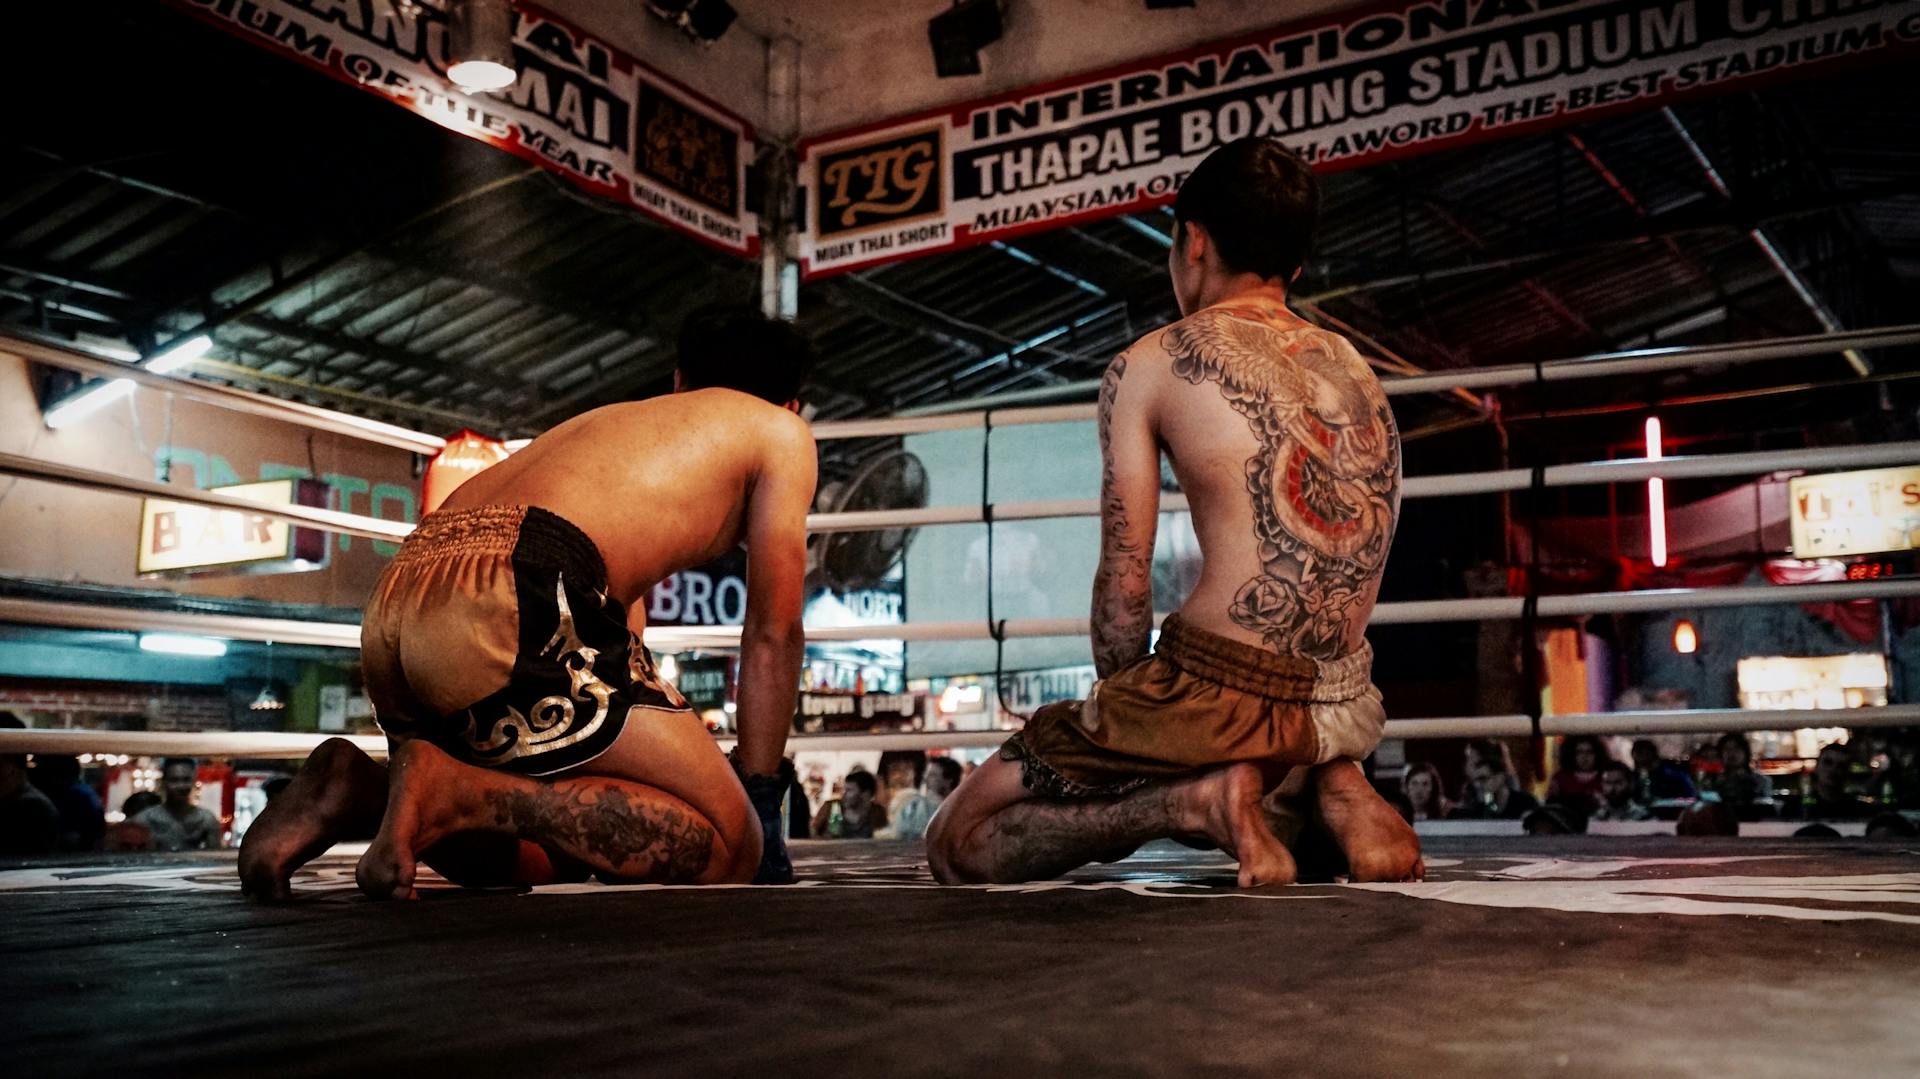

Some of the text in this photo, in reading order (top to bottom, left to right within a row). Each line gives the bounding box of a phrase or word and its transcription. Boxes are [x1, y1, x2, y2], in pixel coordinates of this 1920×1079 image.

[972, 5, 1699, 196] THAPAE BOXING STADIUM
[973, 0, 1572, 141] INTERNATIONA
[1326, 111, 1472, 159] AWORD
[1482, 92, 1557, 126] THE
[1566, 70, 1666, 109] BEST
[1674, 22, 1884, 88] STADIUM
[519, 124, 612, 181] YEAR
[823, 141, 935, 226] TTG
[815, 223, 948, 263] MUAY THAI SHORT
[152, 510, 273, 555] BAR
